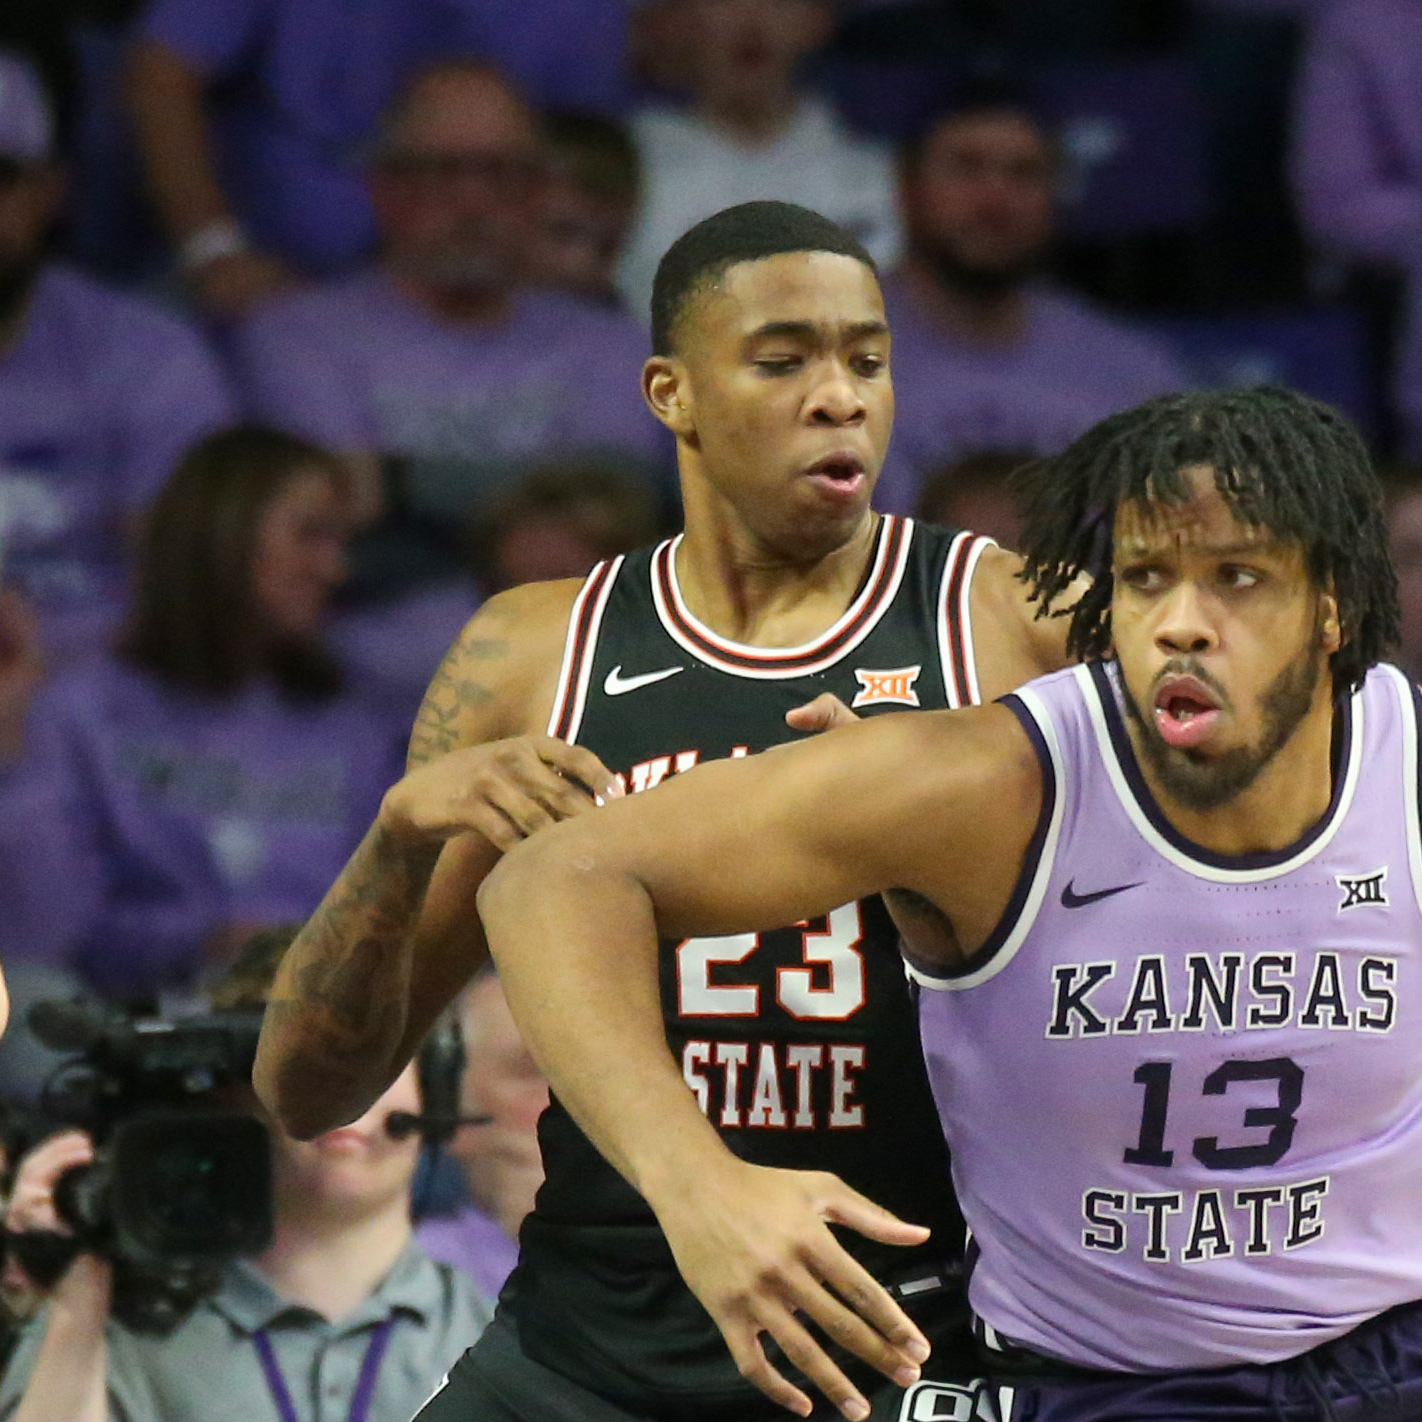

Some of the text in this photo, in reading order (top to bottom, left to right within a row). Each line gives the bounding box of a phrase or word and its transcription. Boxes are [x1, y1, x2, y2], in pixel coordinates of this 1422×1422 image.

[676, 900, 866, 1021] 23
[1044, 951, 1399, 1040] KANSAS
[682, 1040, 866, 1129] STATE
[1123, 1057, 1305, 1170] 13
[1082, 1175, 1330, 1263] STATE
